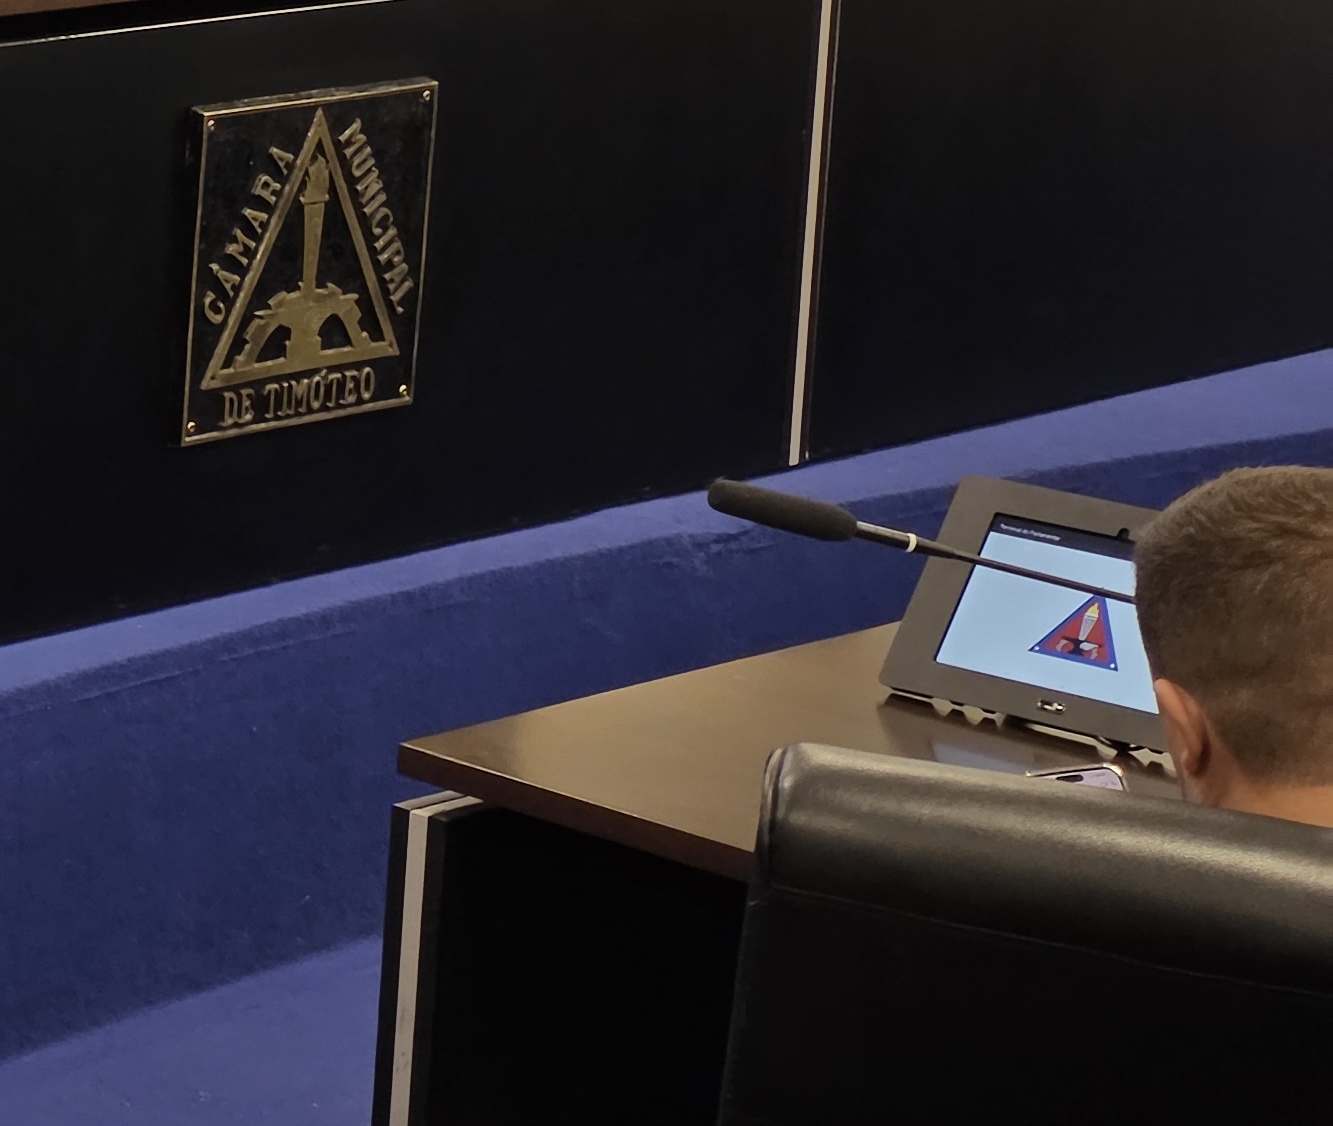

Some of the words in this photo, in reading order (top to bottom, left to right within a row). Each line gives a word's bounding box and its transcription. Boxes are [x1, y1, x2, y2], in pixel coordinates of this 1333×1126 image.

[337, 117, 414, 313] MUNICIPAL
[220, 390, 255, 427] DE
[264, 367, 376, 418] TIMÓTEO
